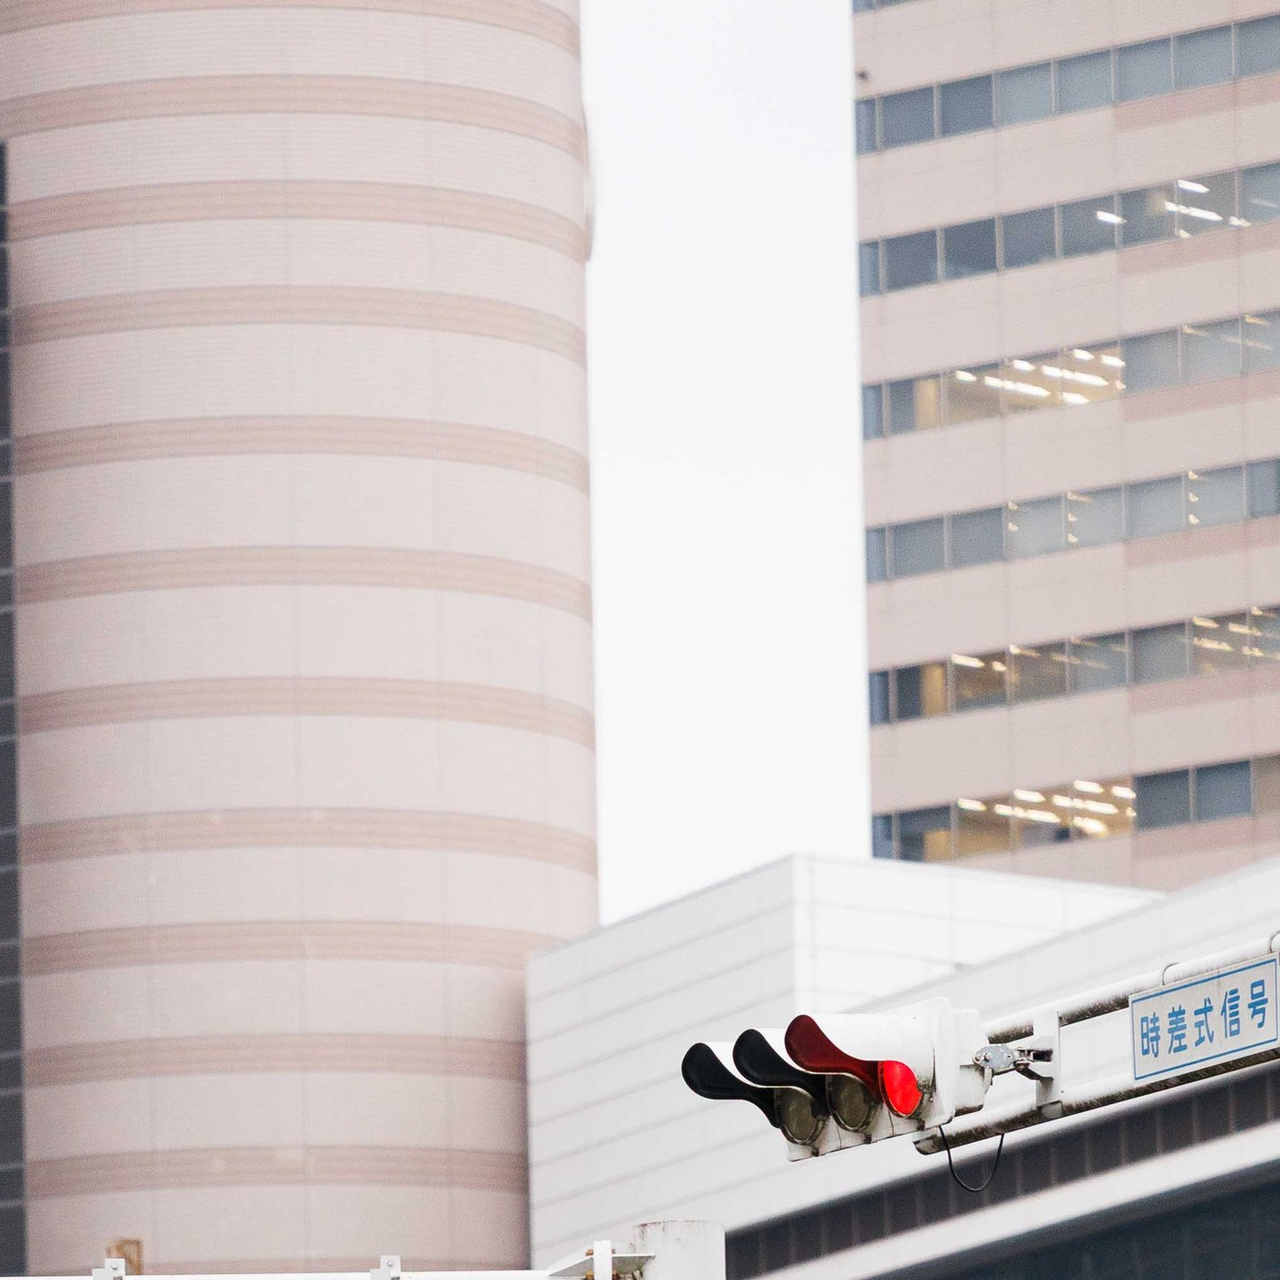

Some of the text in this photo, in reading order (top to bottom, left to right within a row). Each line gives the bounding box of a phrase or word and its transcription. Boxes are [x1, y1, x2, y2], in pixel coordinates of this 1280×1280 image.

[1140, 979, 1269, 1058] 時差式信号
